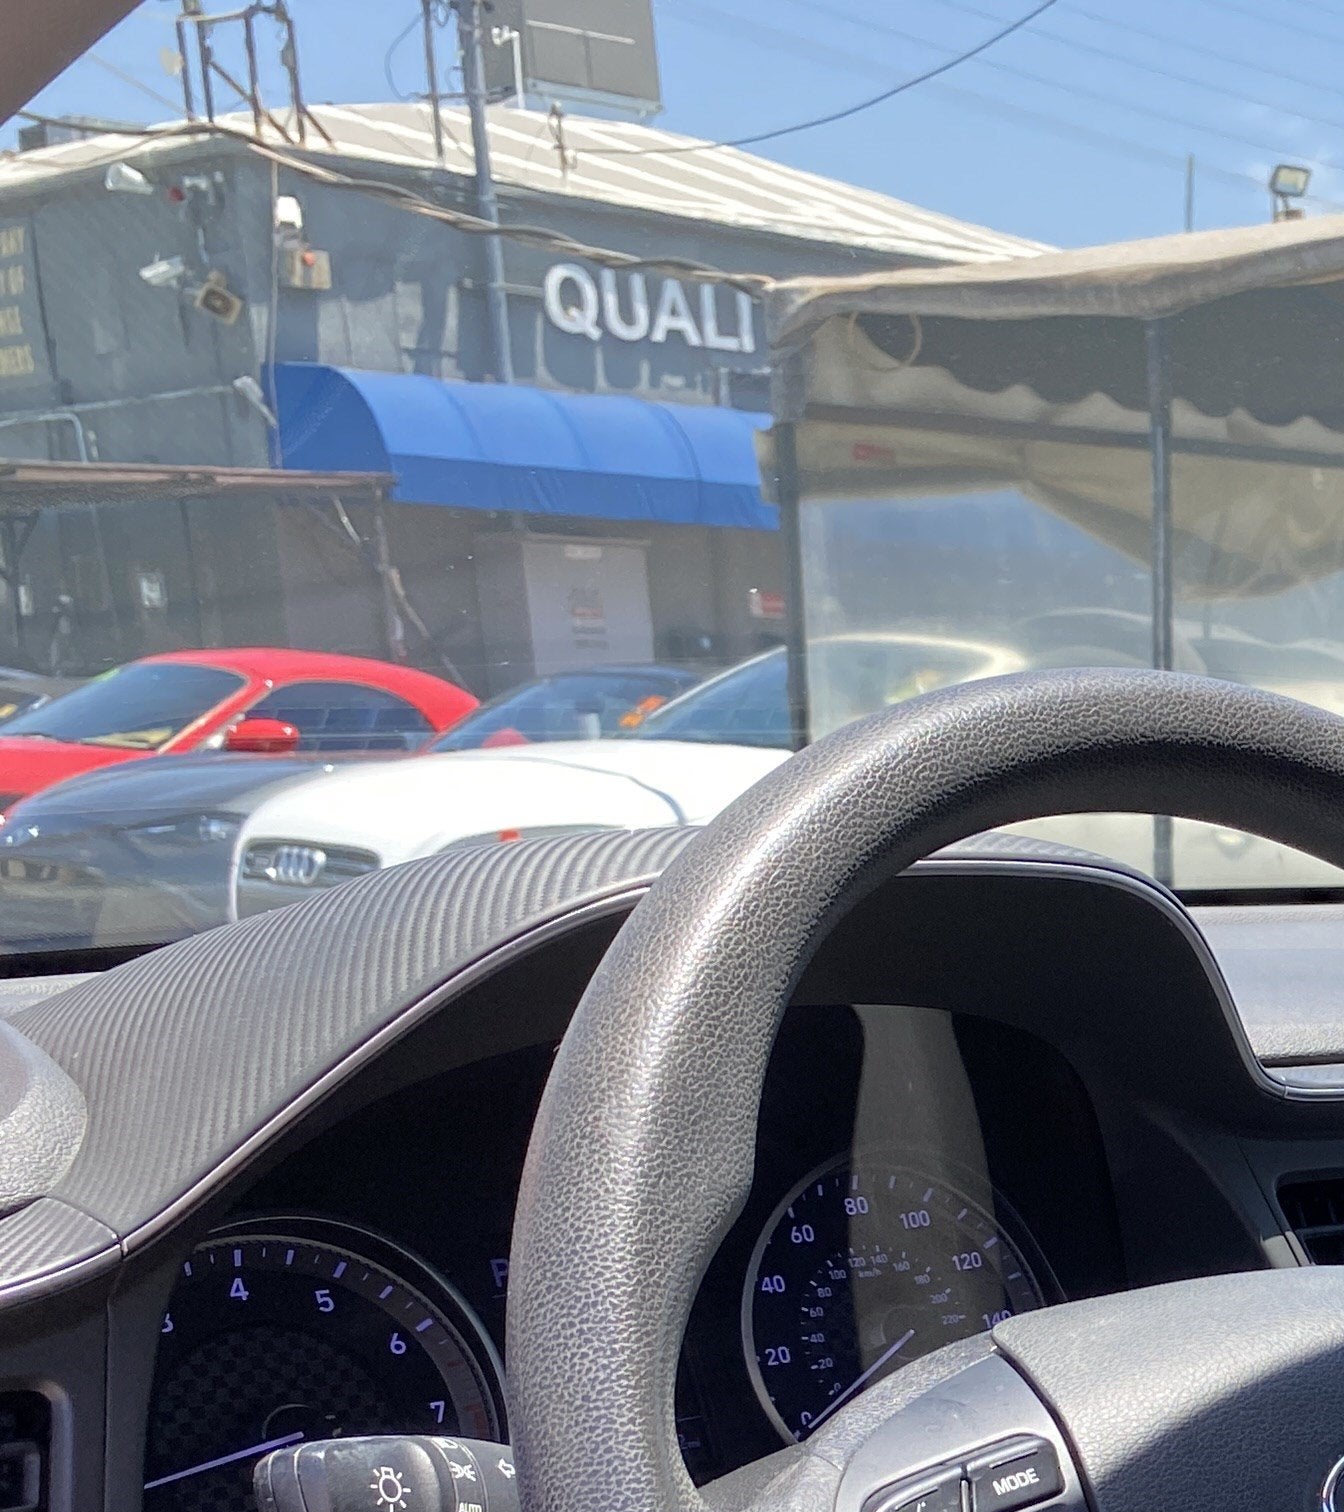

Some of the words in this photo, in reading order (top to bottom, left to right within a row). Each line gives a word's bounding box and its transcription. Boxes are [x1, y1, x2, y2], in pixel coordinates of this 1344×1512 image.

[544, 263, 756, 353] QUALI
[844, 1196, 869, 1216] 80
[900, 1210, 930, 1229] 100
[791, 1224, 815, 1244] 60
[848, 1257, 866, 1268] 120
[870, 1253, 888, 1265] 140
[893, 1261, 910, 1272] 160
[952, 1252, 982, 1271] 120
[828, 1269, 846, 1280] 100
[858, 1268, 882, 1279] km/h
[229, 1277, 250, 1301] 4
[761, 1275, 786, 1293] 40
[817, 1286, 832, 1298] 80
[315, 1289, 336, 1313] 5
[809, 1306, 824, 1318] 60
[390, 1333, 407, 1356] 6
[810, 1333, 825, 1344] 40
[765, 1346, 791, 1366] 20
[818, 1357, 833, 1369] 20
[430, 1401, 446, 1423] 7
[992, 1467, 1040, 1496] MODE
